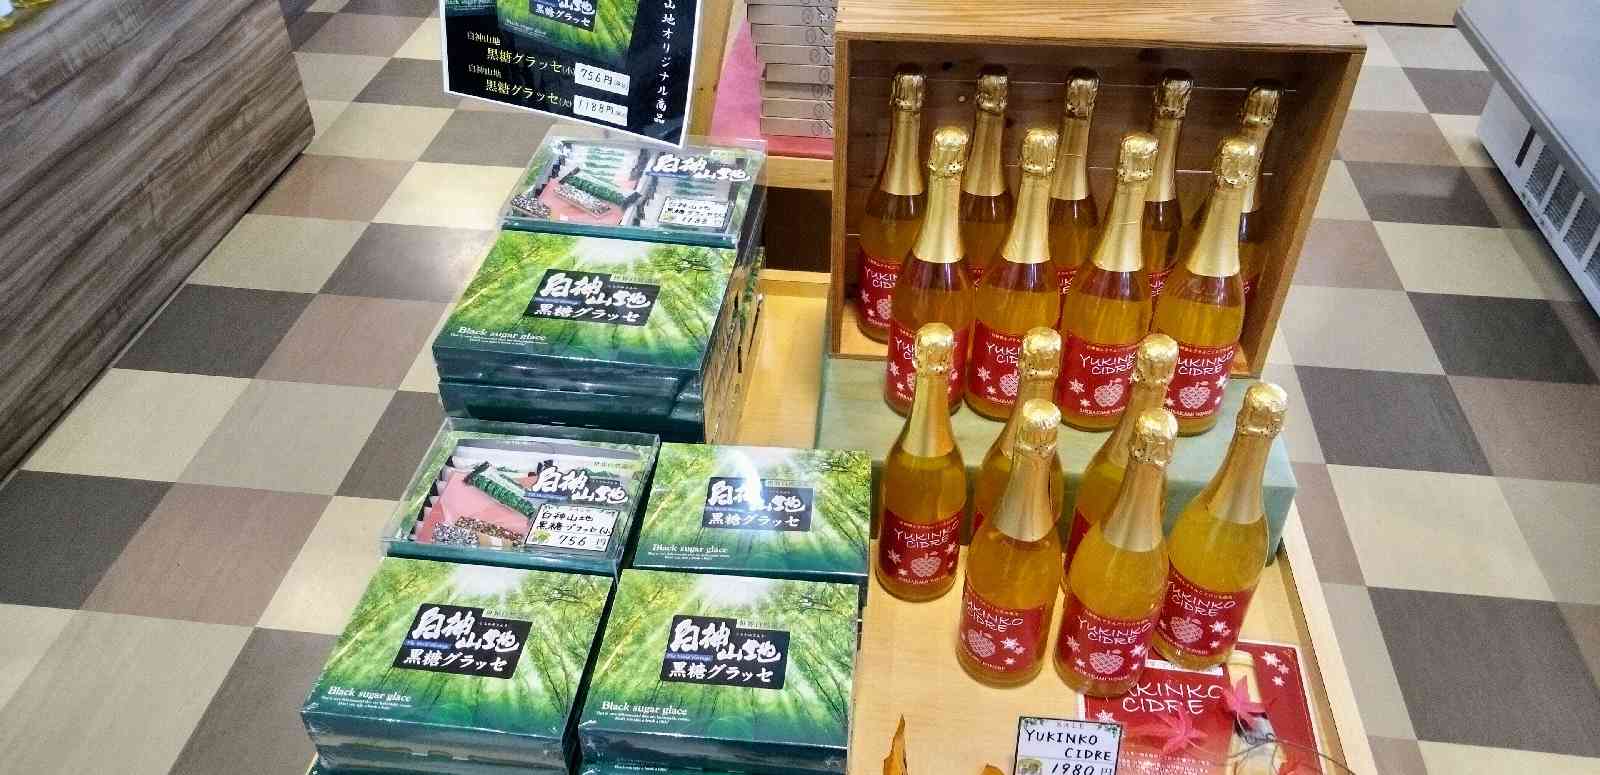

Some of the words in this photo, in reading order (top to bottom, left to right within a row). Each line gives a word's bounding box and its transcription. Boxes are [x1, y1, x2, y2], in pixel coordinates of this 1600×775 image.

[539, 272, 652, 309] 白神山地
[533, 303, 641, 323] 黒糖グラッセ
[458, 326, 488, 336] Black
[1178, 364, 1223, 376] CIDRE
[532, 466, 628, 505] 白神山地
[542, 511, 594, 522] 白神山地
[708, 512, 801, 527] 黒糖グラッセ
[559, 534, 588, 547] 756
[411, 606, 520, 653] 白神山地
[1077, 615, 1152, 637] YUKINKO
[669, 618, 782, 662] 白神山地
[1087, 630, 1137, 645] CIDRE
[402, 648, 508, 672] 黒糖グラッセ
[668, 660, 774, 683] 黒糖グラッセ
[327, 685, 355, 697] Black
[358, 690, 385, 700] sugar
[386, 692, 412, 702] glace
[601, 700, 630, 712] Black
[632, 703, 661, 714] sugar
[662, 705, 688, 716] glace
[1025, 729, 1098, 745] YUKINKO
[1064, 747, 1112, 761] CIDRE
